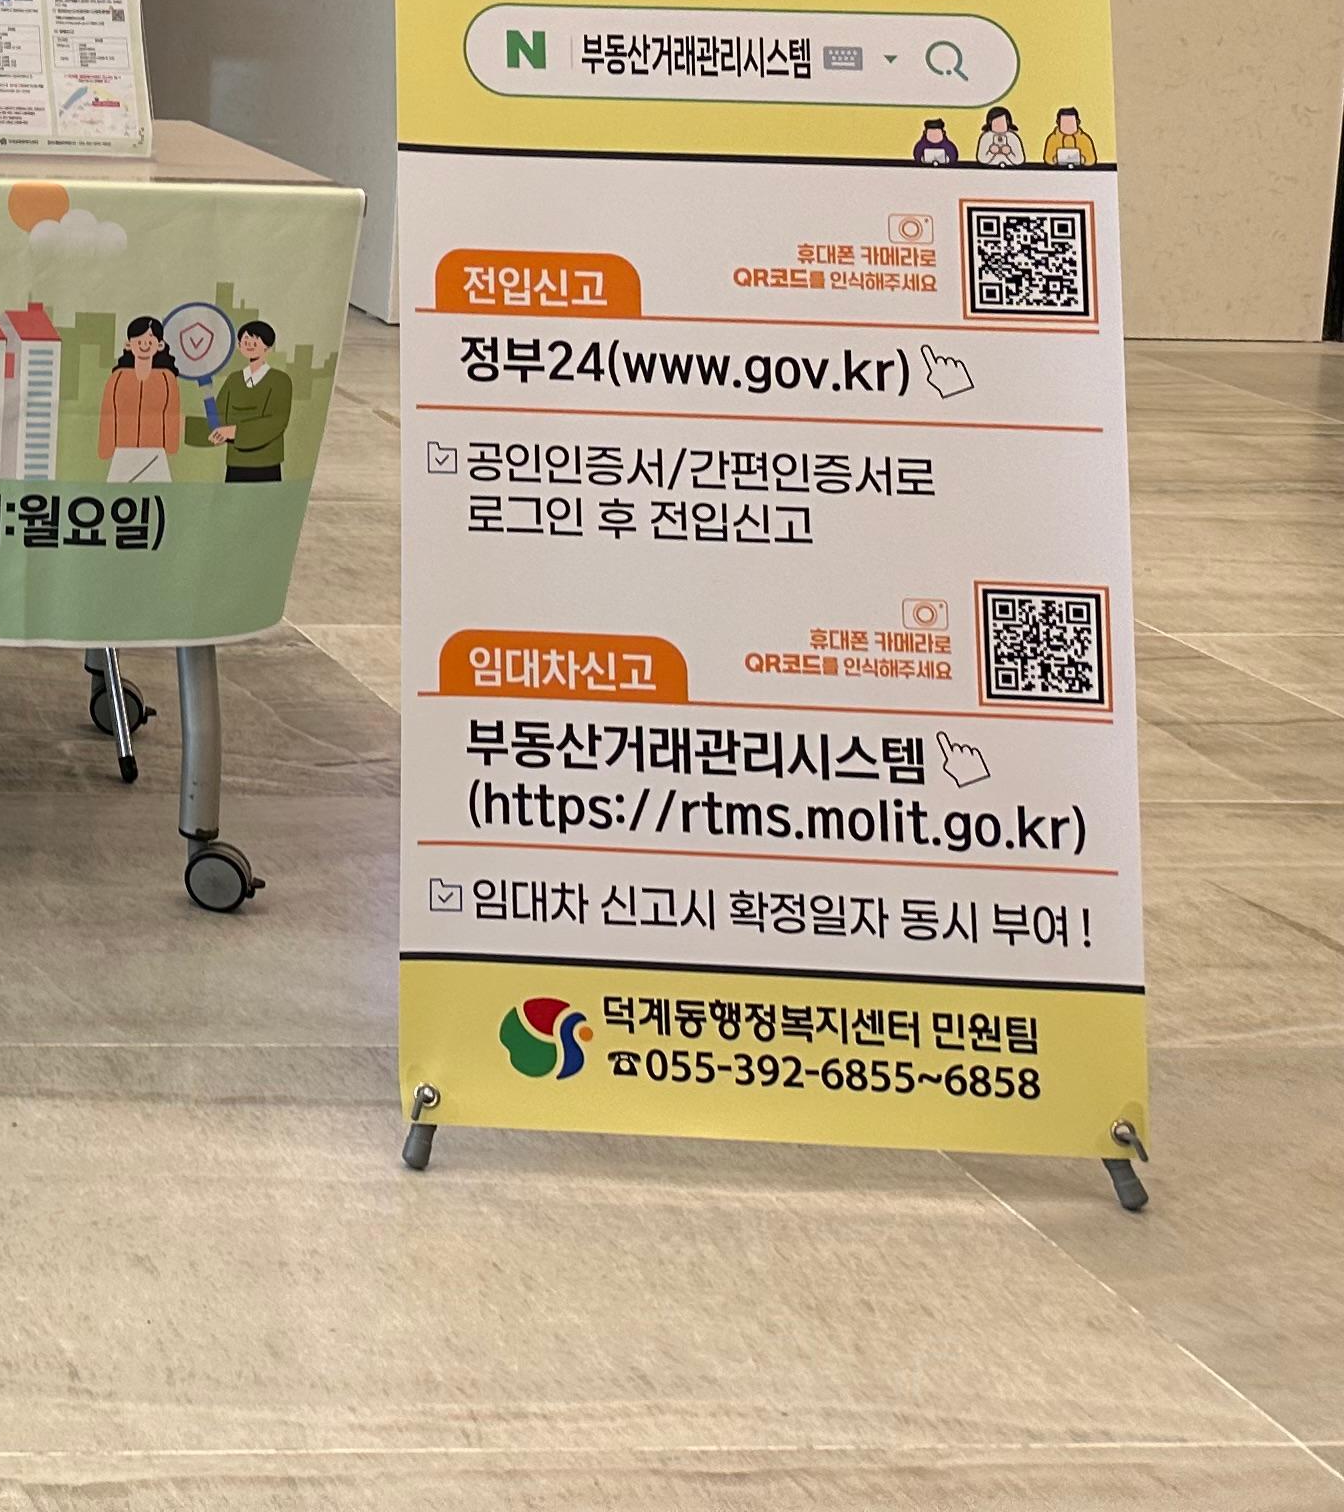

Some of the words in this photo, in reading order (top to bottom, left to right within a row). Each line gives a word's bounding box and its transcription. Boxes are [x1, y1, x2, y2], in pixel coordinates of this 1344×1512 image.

[508, 30, 547, 69] N
[581, 34, 812, 80] 부동산거래관리시스템
[797, 243, 856, 266] 휴대폰
[861, 245, 937, 269] 카메라로
[462, 266, 608, 308] 전입신고
[830, 271, 938, 294] 인식해주세요
[459, 335, 911, 398] 정부24(www.gov.kr)
[467, 442, 936, 498] 공인인증서/간편인증서로
[467, 497, 583, 538] 로그인
[598, 499, 637, 540] 후
[650, 501, 814, 546] 전입신고
[809, 627, 869, 651] 휴대폰
[874, 630, 952, 655] 카메라로
[468, 646, 656, 692] 임대차신고
[843, 656, 953, 681] 인식해주세요
[466, 719, 926, 786] 부동산거래관리시스템
[468, 778, 1088, 856] (https://rtms.molit.go.kr)
[473, 879, 589, 925] 임대차
[600, 883, 716, 932] 신고시
[729, 888, 890, 939] 확정일자
[899, 897, 979, 944] 동시
[992, 904, 1070, 949] 부여
[603, 995, 922, 1050] 덕계동행정복지센터
[931, 1010, 1040, 1056] 민원팀
